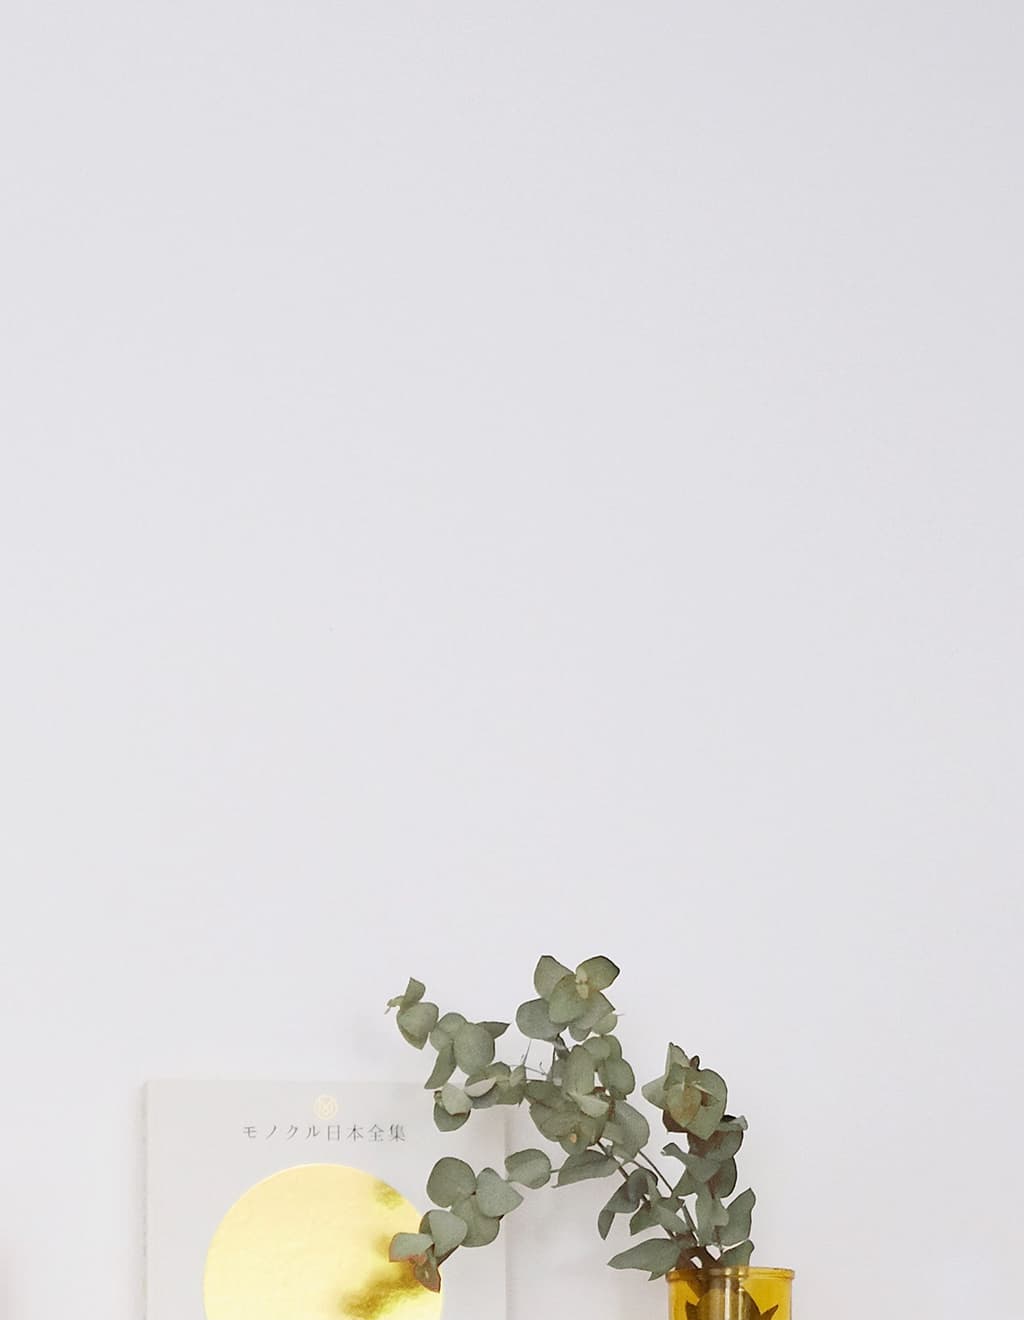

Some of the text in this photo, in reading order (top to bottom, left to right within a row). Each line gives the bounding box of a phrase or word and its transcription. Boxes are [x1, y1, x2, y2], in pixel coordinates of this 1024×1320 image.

[242, 1123, 406, 1142] モノクル日本全集
